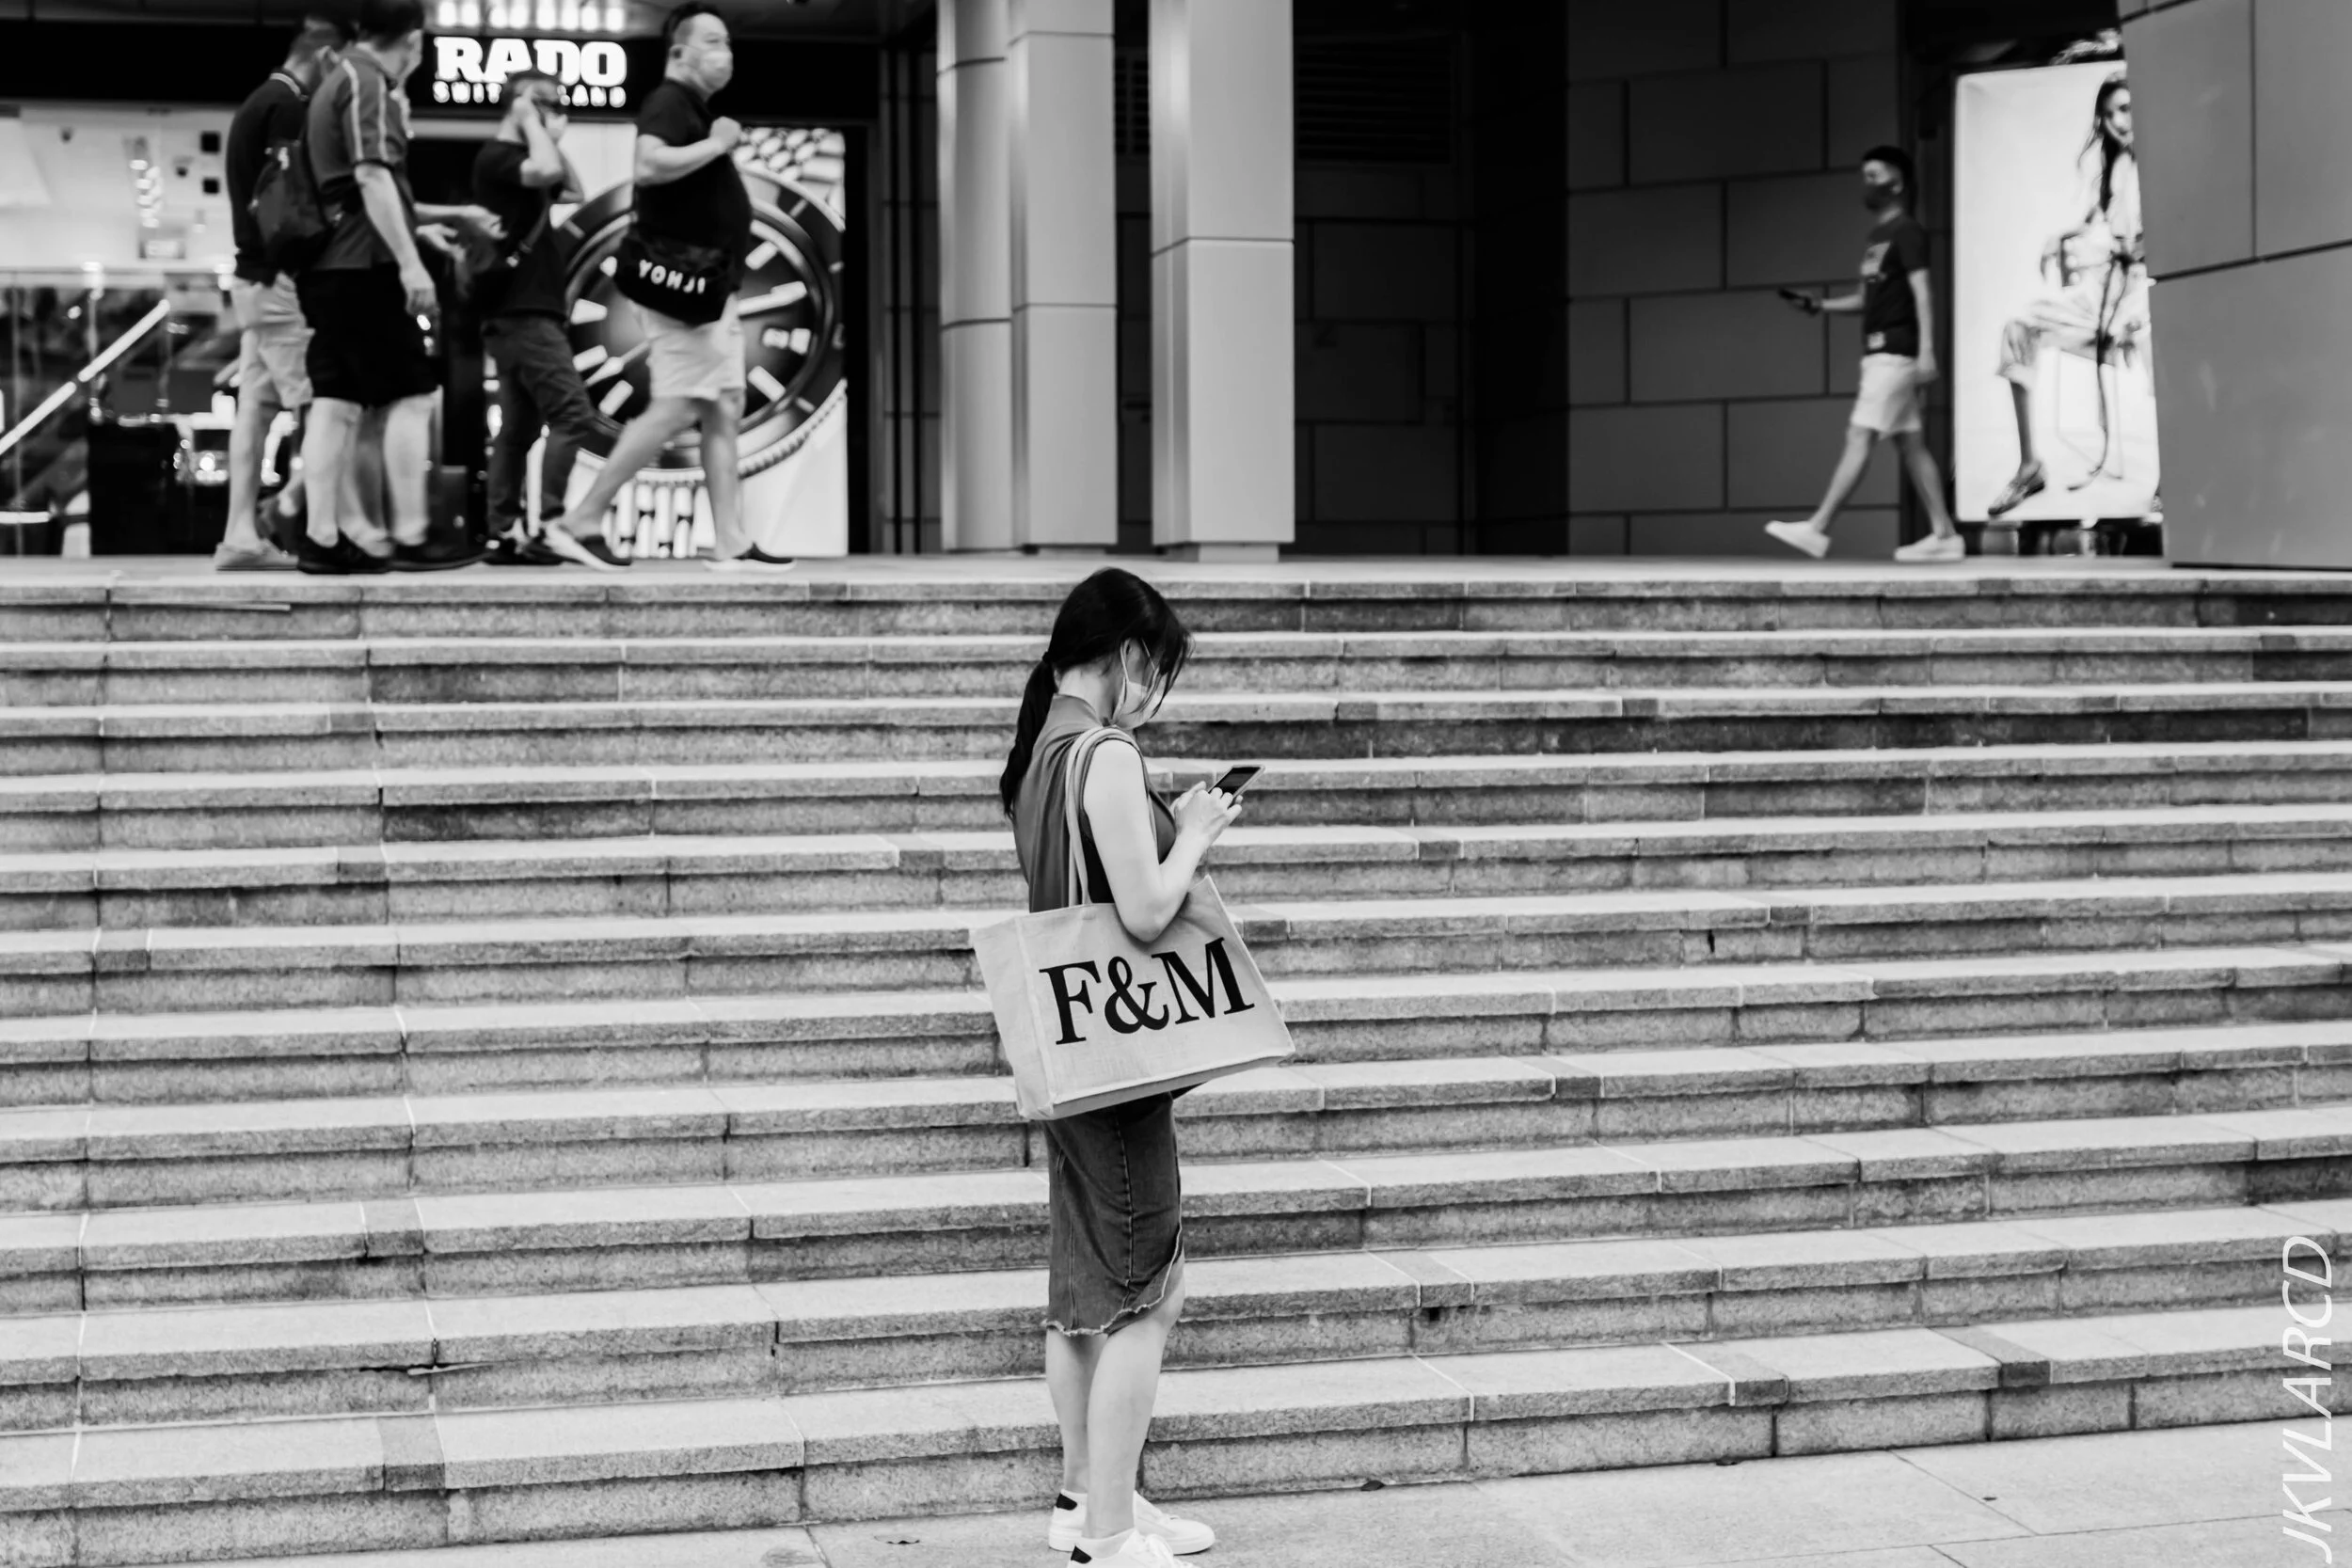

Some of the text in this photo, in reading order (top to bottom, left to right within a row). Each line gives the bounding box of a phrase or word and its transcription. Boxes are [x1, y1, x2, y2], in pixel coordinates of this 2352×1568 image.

[434, 36, 627, 87] RADO
[433, 81, 627, 108] SWITLAND
[639, 259, 706, 293] YOHJI
[1039, 937, 1255, 1045] F&M
